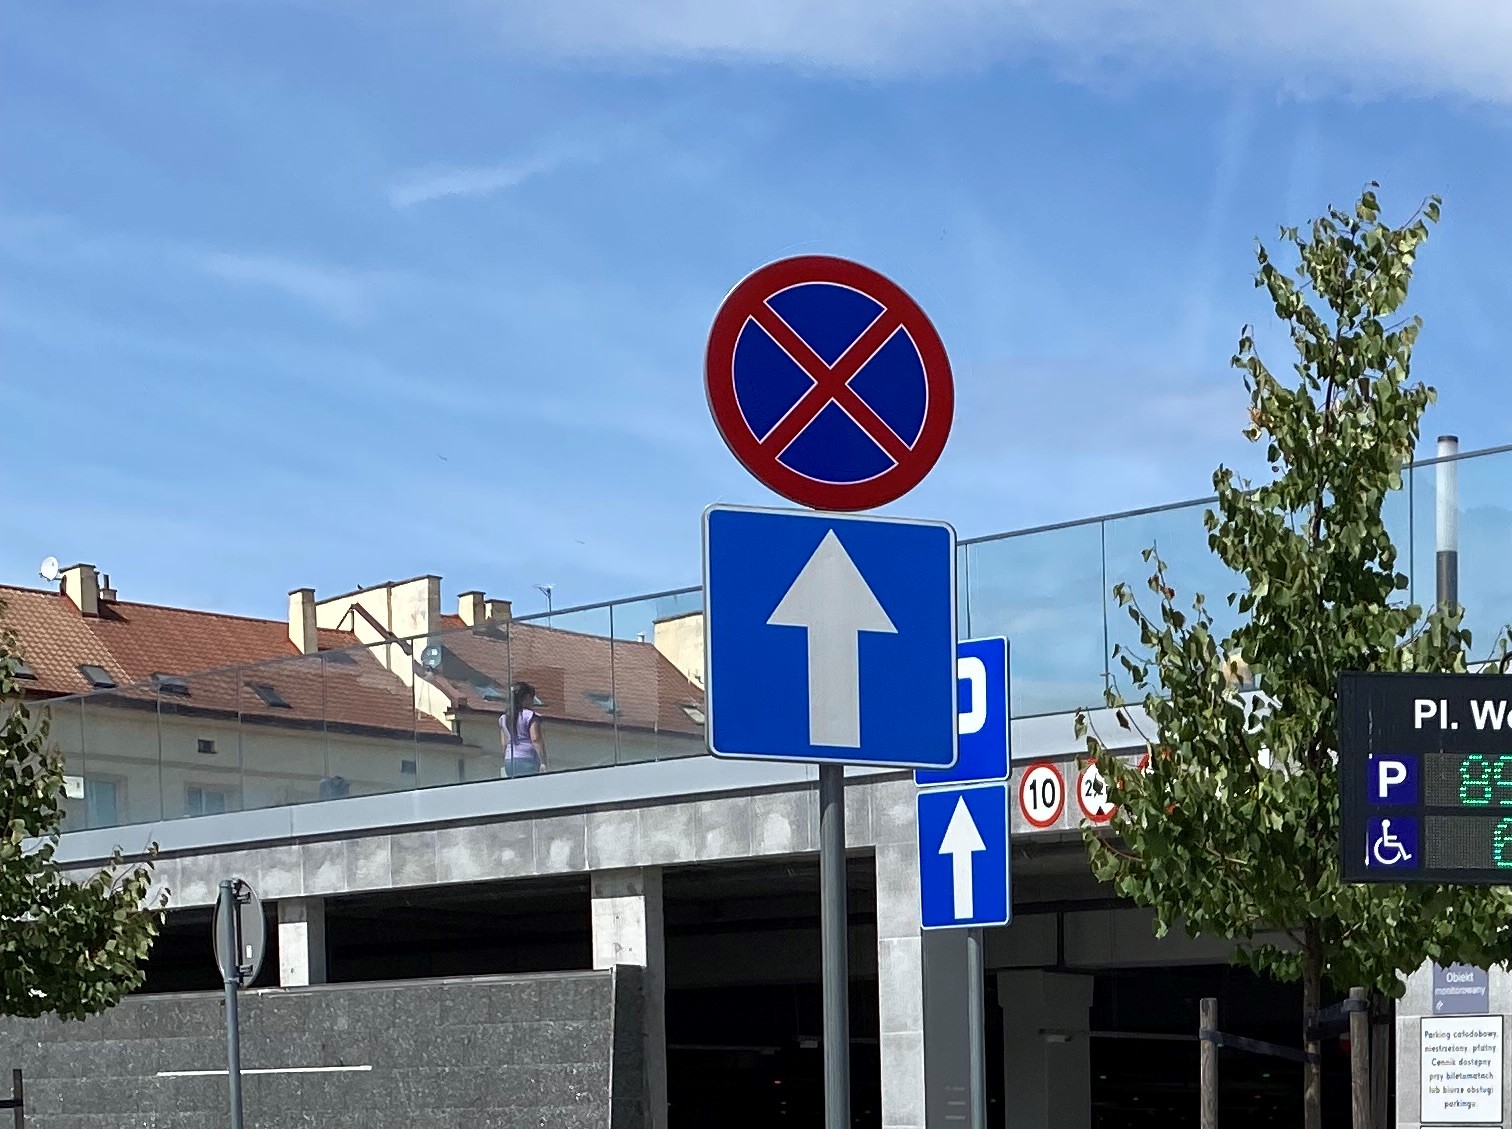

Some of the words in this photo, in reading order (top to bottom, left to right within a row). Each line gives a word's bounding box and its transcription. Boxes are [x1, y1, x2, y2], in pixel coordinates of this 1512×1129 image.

[1414, 699, 1458, 730] Pl.
[1378, 761, 1407, 797] P
[1029, 778, 1056, 809] 10
[1446, 972, 1474, 982] Obiekt
[1425, 1031, 1450, 1040] Parking
[1432, 1058, 1456, 1066] Cennik
[1429, 1074, 1443, 1082] przy
